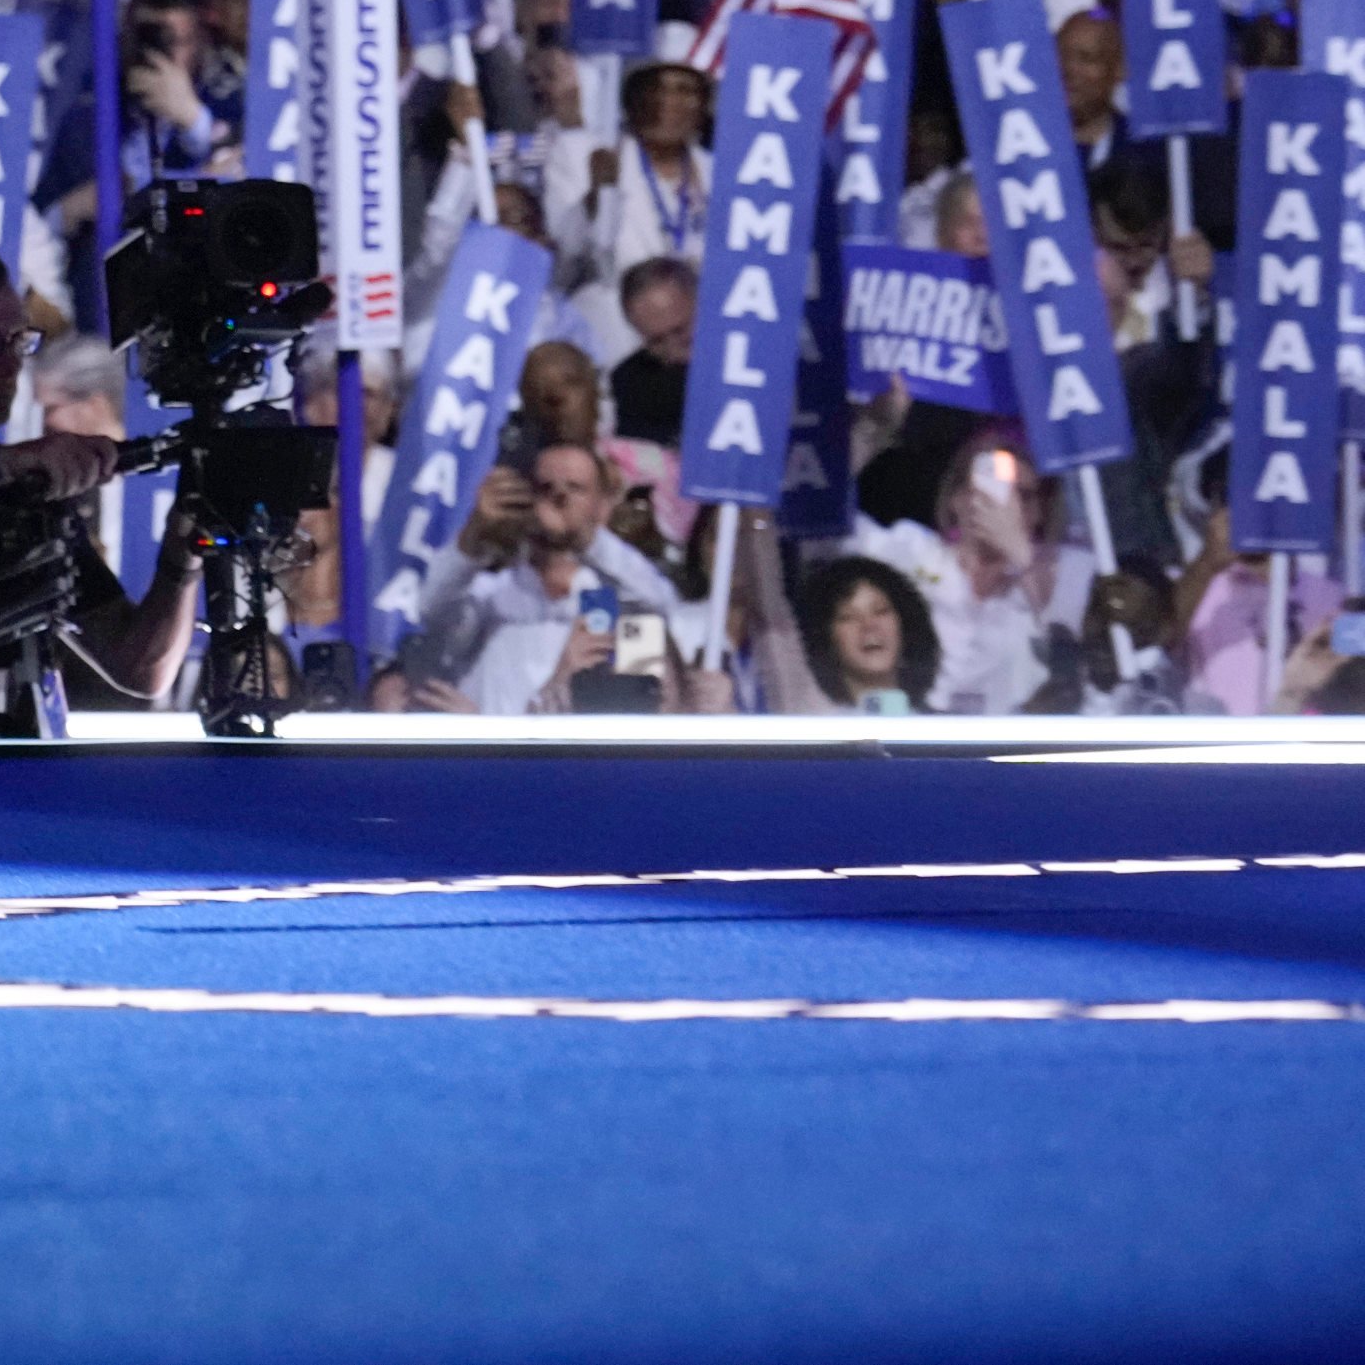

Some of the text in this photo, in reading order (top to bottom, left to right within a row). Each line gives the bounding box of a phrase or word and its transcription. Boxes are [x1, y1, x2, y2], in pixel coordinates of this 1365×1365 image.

[700, 64, 802, 456] KAMALA
[841, 266, 1009, 353] HARRIS
[857, 336, 978, 404] WALZ
[975, 41, 1102, 422] KAMALA
[1255, 122, 1322, 506] KAMALA
[377, 273, 520, 626] KAMALA
